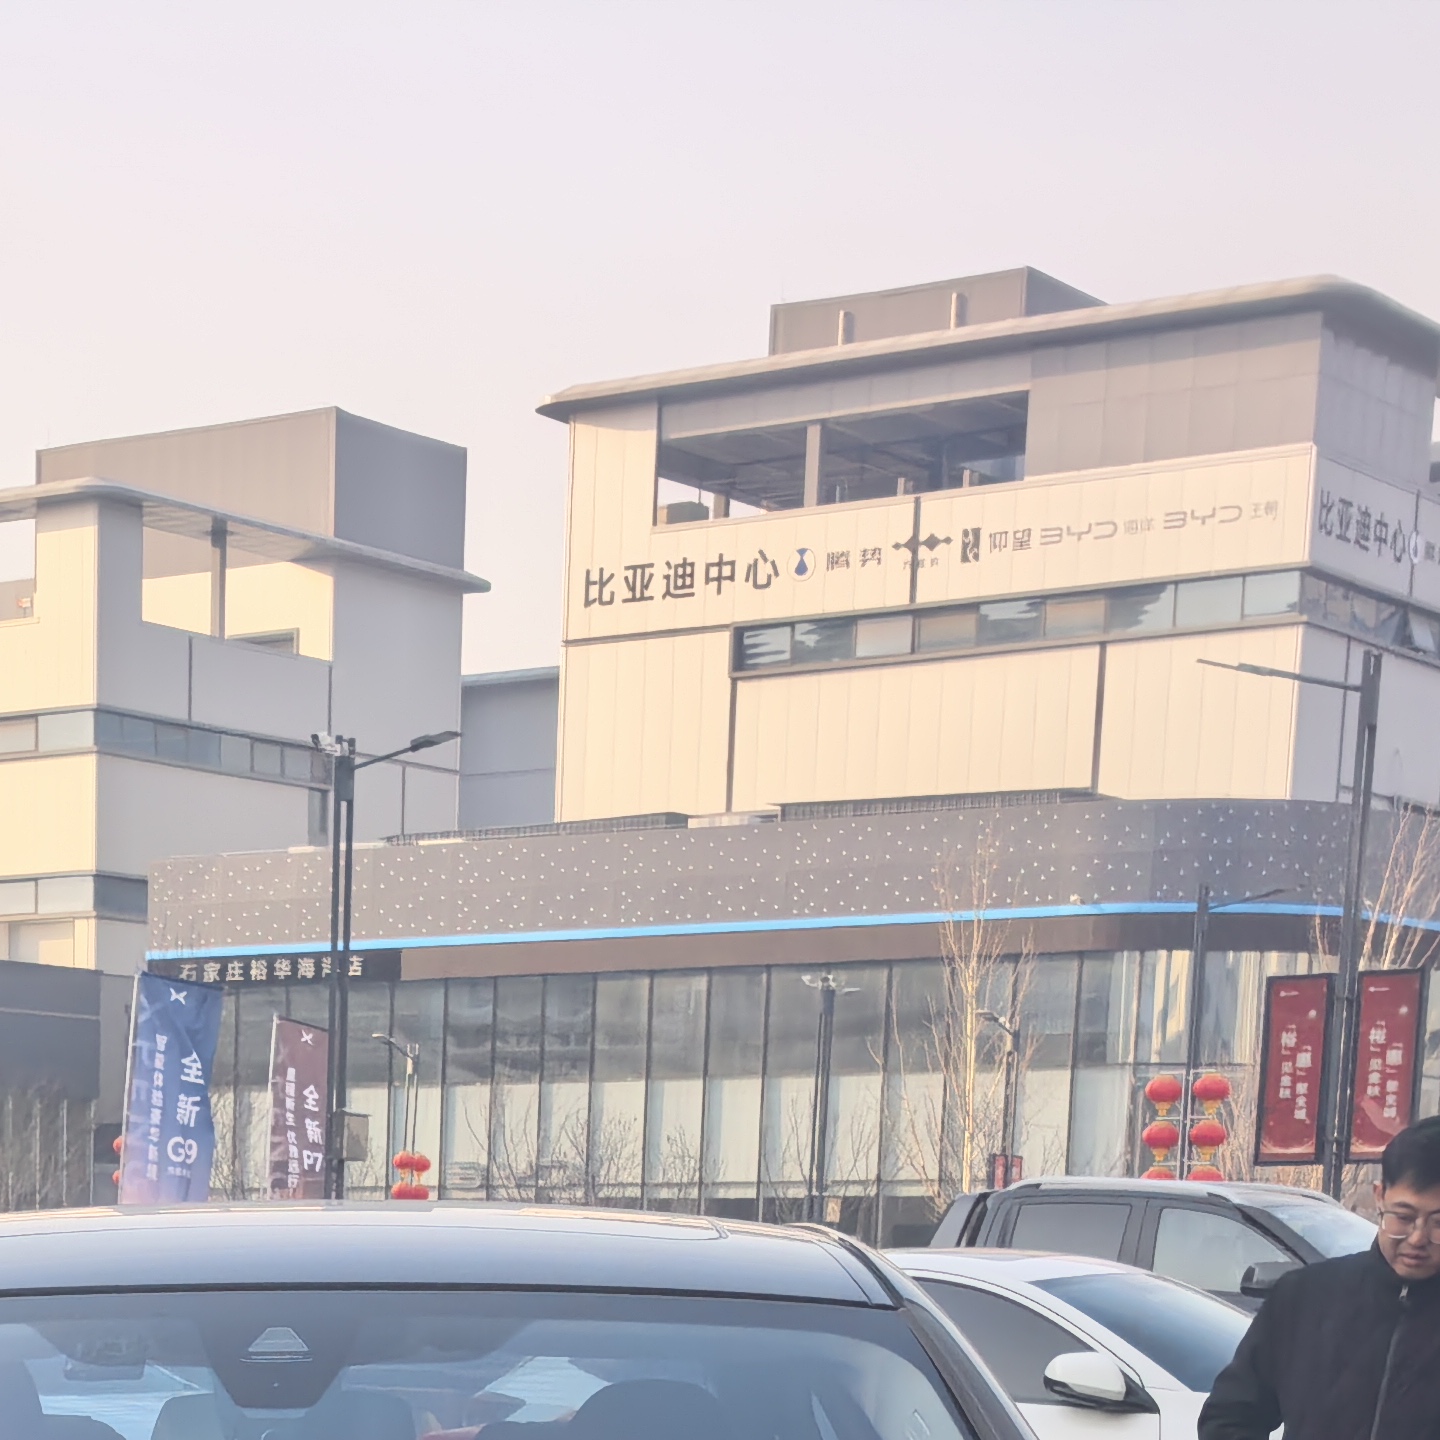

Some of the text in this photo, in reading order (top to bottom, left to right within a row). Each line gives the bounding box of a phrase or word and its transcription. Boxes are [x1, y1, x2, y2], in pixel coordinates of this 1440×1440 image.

[584, 549, 779, 608] 比亚迪中心
[1040, 520, 1118, 546] BYD
[1163, 505, 1243, 530] BYD
[1319, 487, 1406, 564] 比亚迪中心
[176, 1050, 205, 1128] 全新
[166, 1136, 198, 1165] G9
[302, 1084, 323, 1173] 全新 P7
